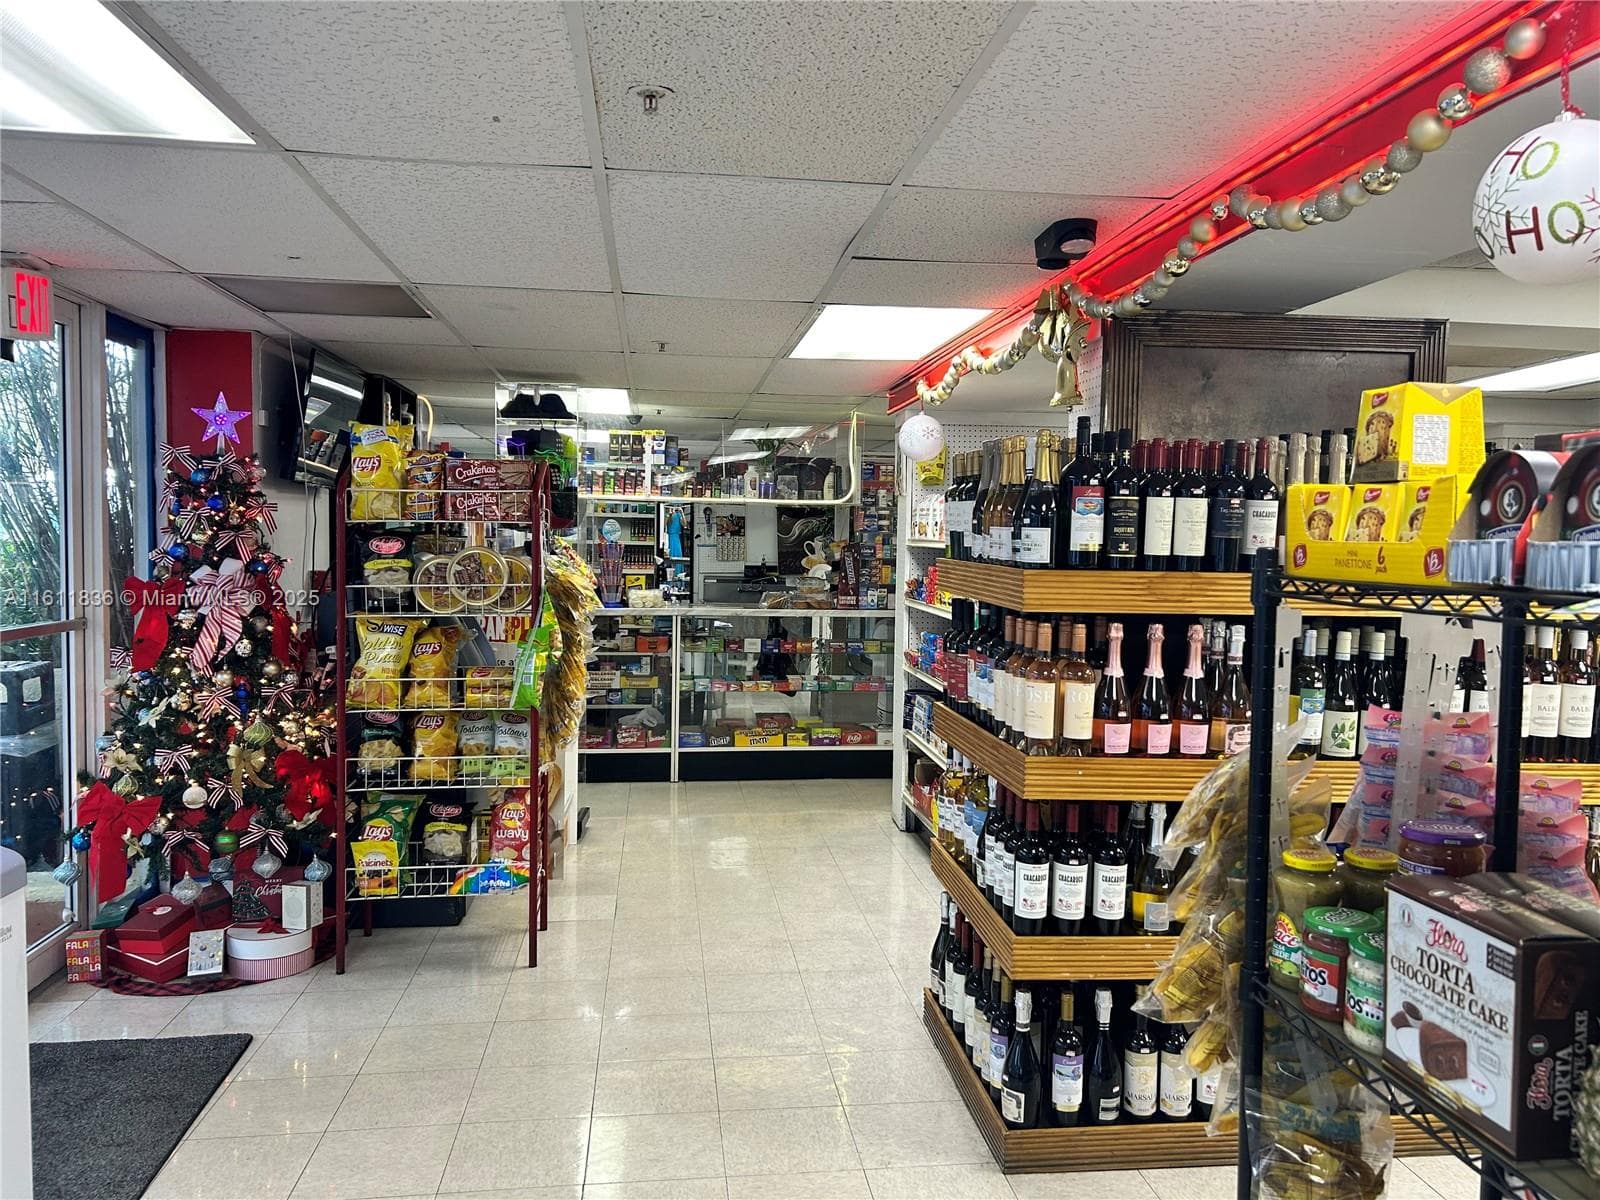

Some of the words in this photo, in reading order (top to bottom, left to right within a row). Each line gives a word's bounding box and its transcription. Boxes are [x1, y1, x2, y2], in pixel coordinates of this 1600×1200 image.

[15, 272, 49, 334] EXIT
[353, 456, 380, 472] Lay's
[1377, 546, 1386, 565] 6
[1334, 558, 1373, 570] PANETTONE
[1375, 565, 1387, 574] pack
[383, 624, 405, 635] WISE
[414, 642, 441, 656] Lay's
[417, 715, 443, 730] Lay's
[502, 808, 526, 821] Lay's
[363, 824, 392, 841] Lay's
[496, 828, 529, 841] wavy
[1425, 918, 1469, 965] Flora
[1416, 946, 1475, 995] TORTA
[1390, 955, 1465, 1010] CHOCOLATE
[1468, 998, 1509, 1033] CAKE
[1574, 1010, 1589, 1053] CAKE
[1553, 1045, 1573, 1120] TORTA
